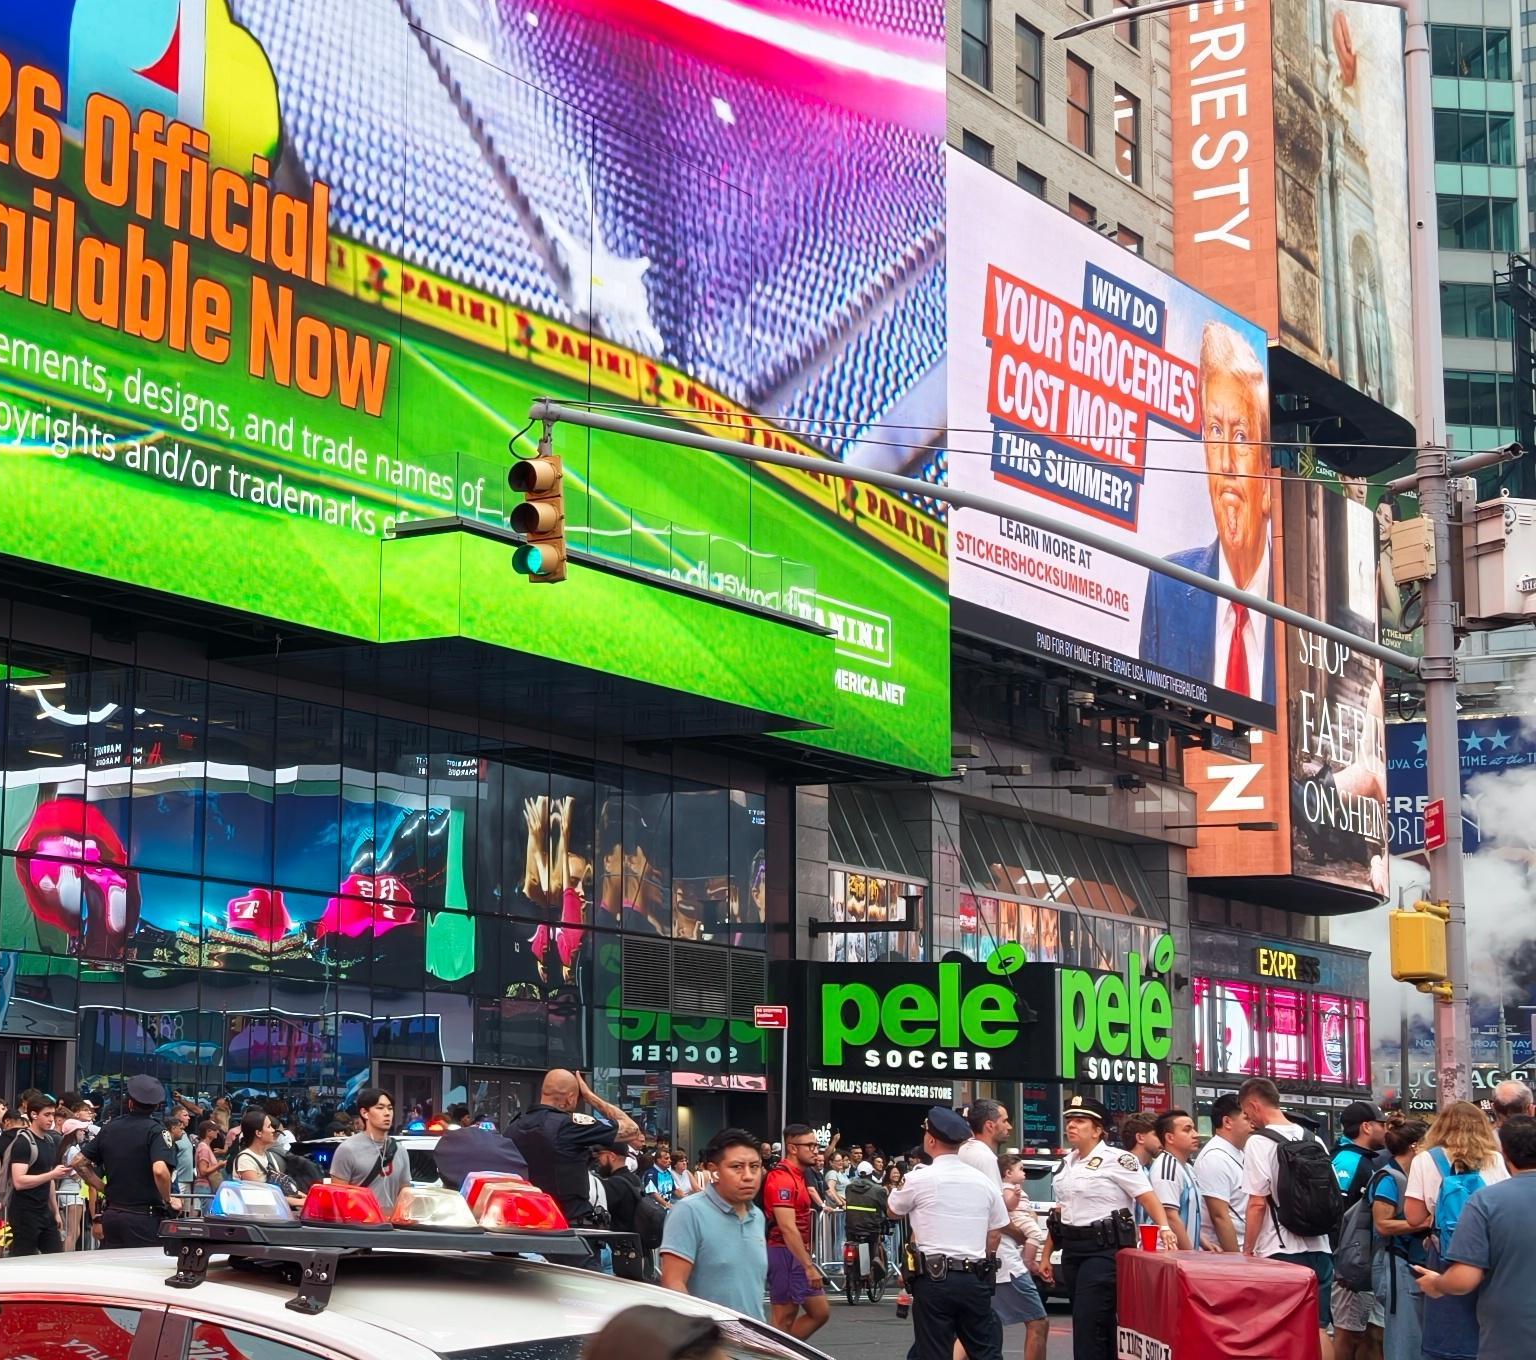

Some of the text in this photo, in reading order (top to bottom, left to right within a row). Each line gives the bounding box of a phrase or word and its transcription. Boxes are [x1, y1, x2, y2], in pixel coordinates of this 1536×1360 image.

[82, 91, 331, 285] Official
[400, 270, 499, 329] PANINI
[1091, 274, 1159, 336] WHY DO
[247, 276, 393, 419] Now
[545, 328, 632, 379] PANINI
[994, 275, 1197, 425] YOUR GROCERIES
[997, 354, 1139, 466] COST MORE
[123, 364, 236, 438] designs,
[244, 413, 296, 454] and
[301, 424, 370, 476] trade
[375, 452, 455, 502] names
[461, 478, 486, 520] of
[998, 429, 1133, 513] THIS SUMMER?
[124, 440, 222, 491] and/or
[228, 464, 376, 536] trademarks
[956, 530, 1130, 613] STICKERSHOCKSUMMER.ORG
[999, 516, 1093, 571] LEARN MORE AT
[1051, 636, 1065, 657] FOR
[1298, 627, 1350, 678] SHOP
[1460, 754, 1487, 766] TIME
[1303, 780, 1335, 828] ON
[1338, 789, 1385, 843] SHEIN
[822, 941, 1020, 1066] pelé
[1062, 933, 1173, 1080] pelé
[812, 1077, 952, 1100] THE WORLD'S GREATEST SOCCER STORE
[865, 1049, 1159, 1084] SOCCER SOCCER
